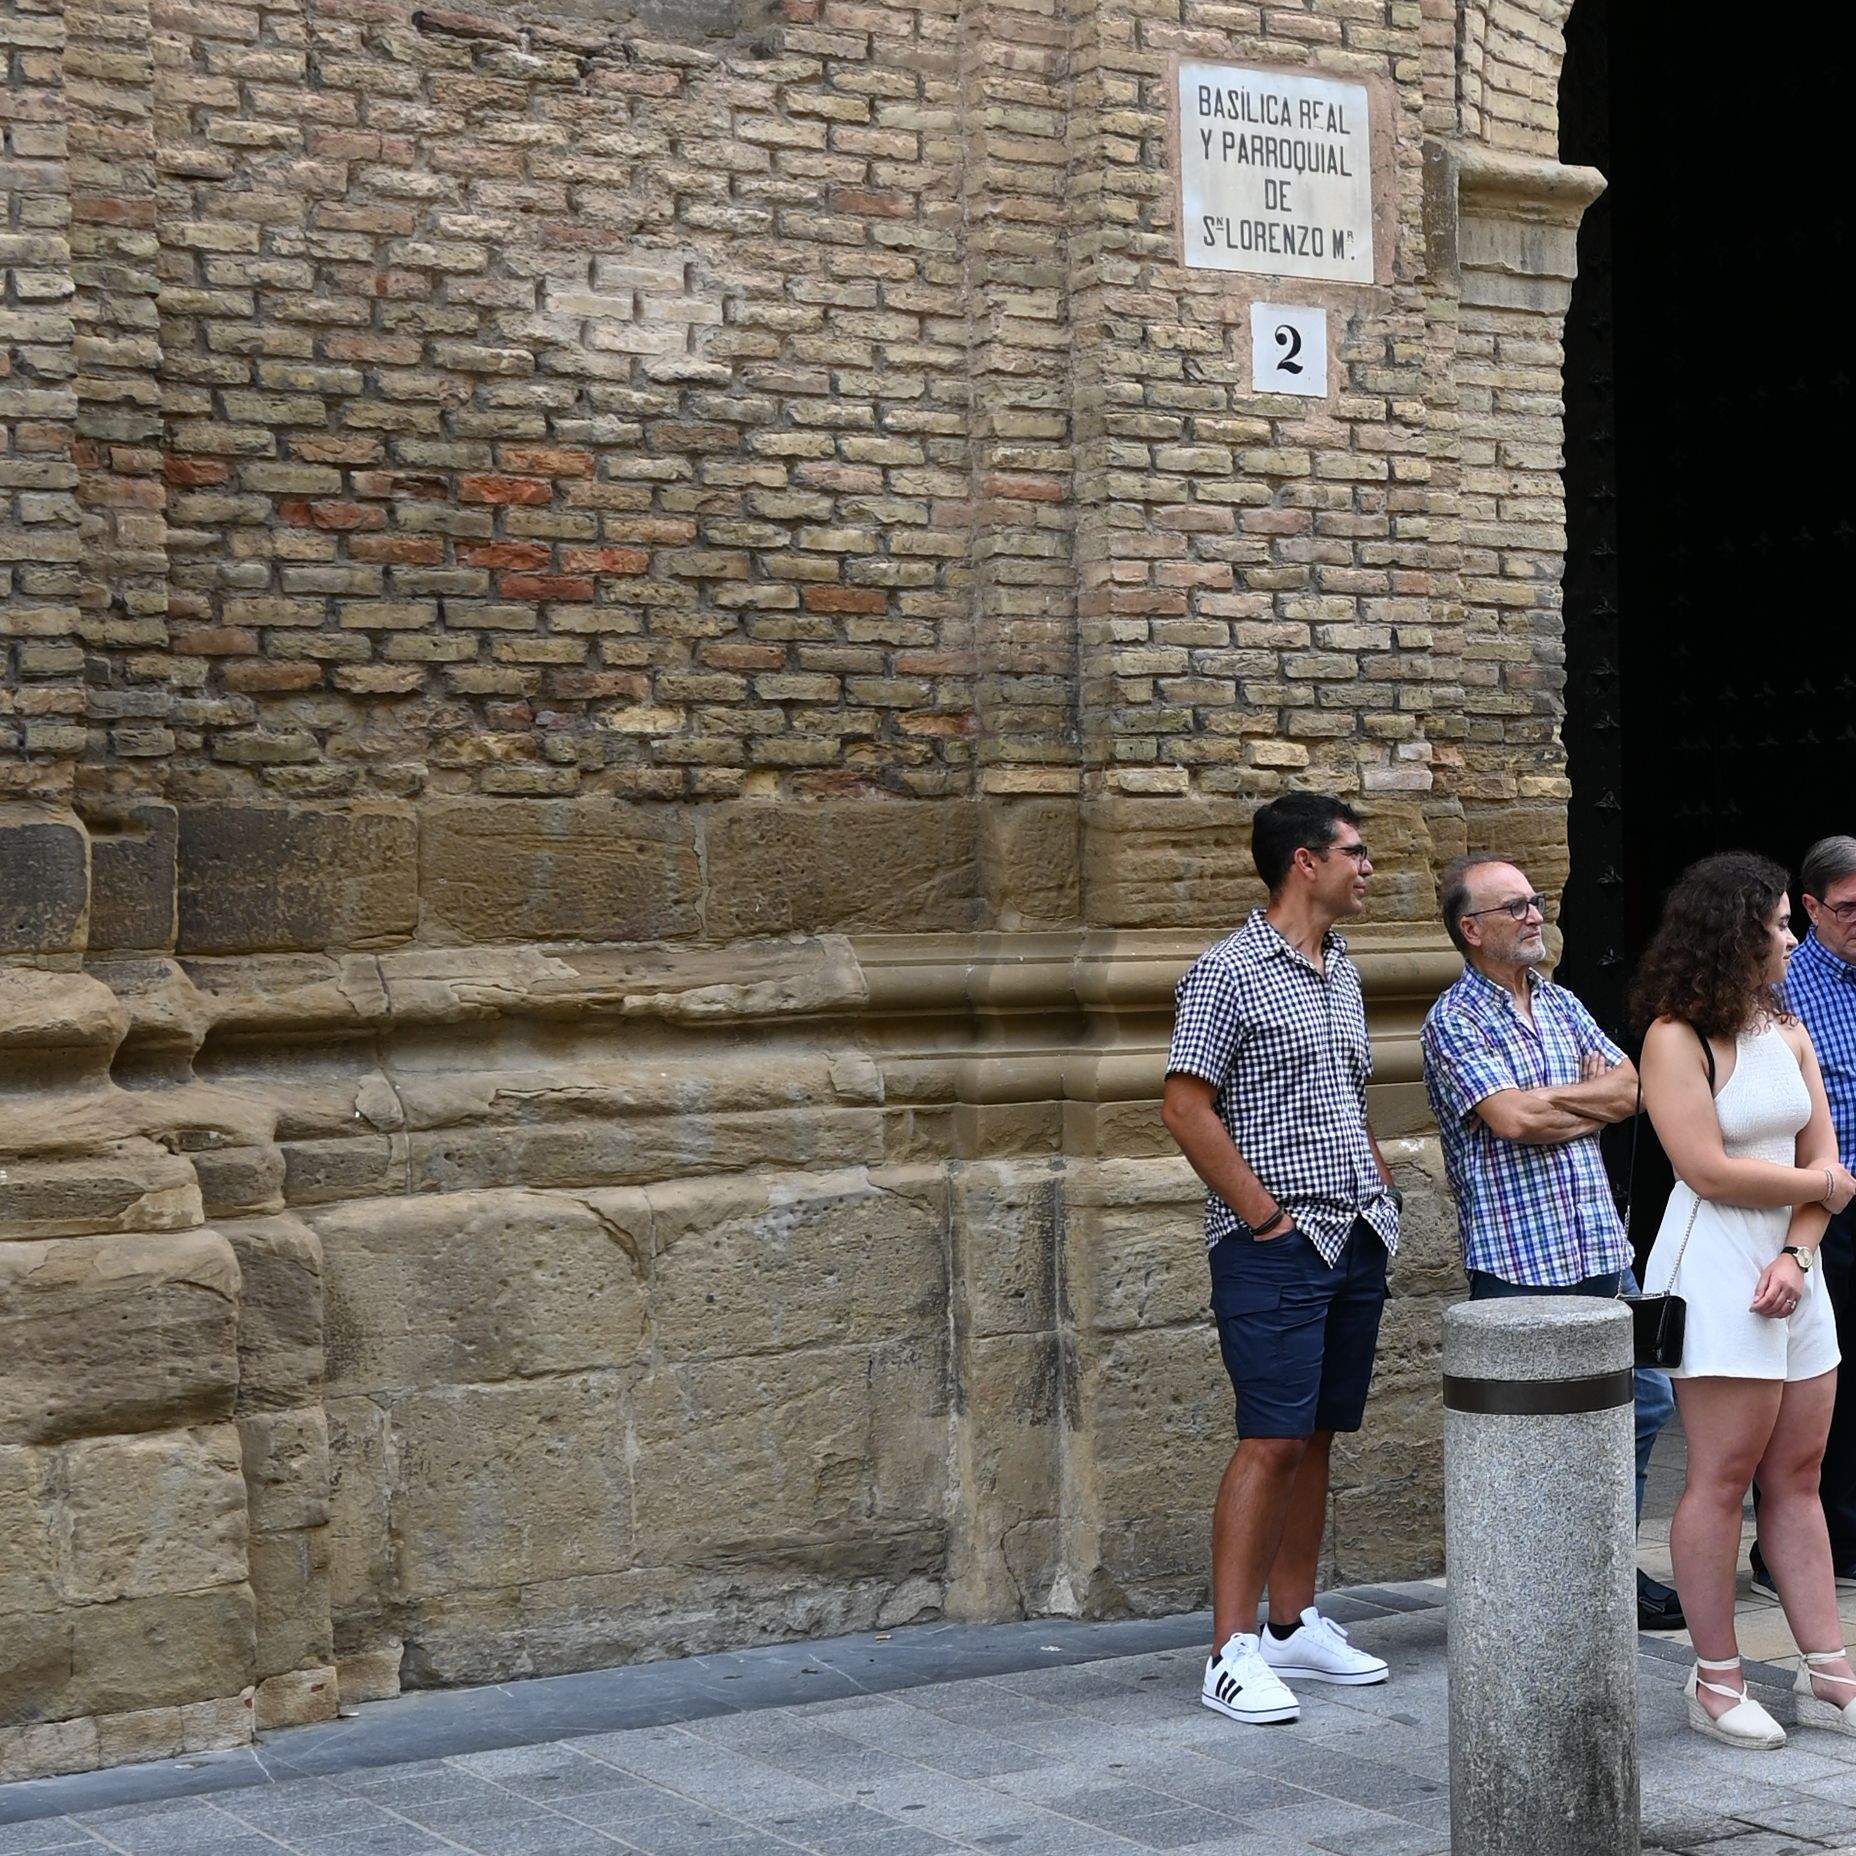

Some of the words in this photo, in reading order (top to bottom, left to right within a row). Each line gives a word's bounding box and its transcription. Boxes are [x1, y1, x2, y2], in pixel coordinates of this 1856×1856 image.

[1300, 100, 1350, 135] REAL
[1200, 128, 1213, 160] Y
[1223, 131, 1352, 177] PARROQUIAL
[1264, 179, 1292, 212] DE
[1274, 324, 1304, 375] 2
